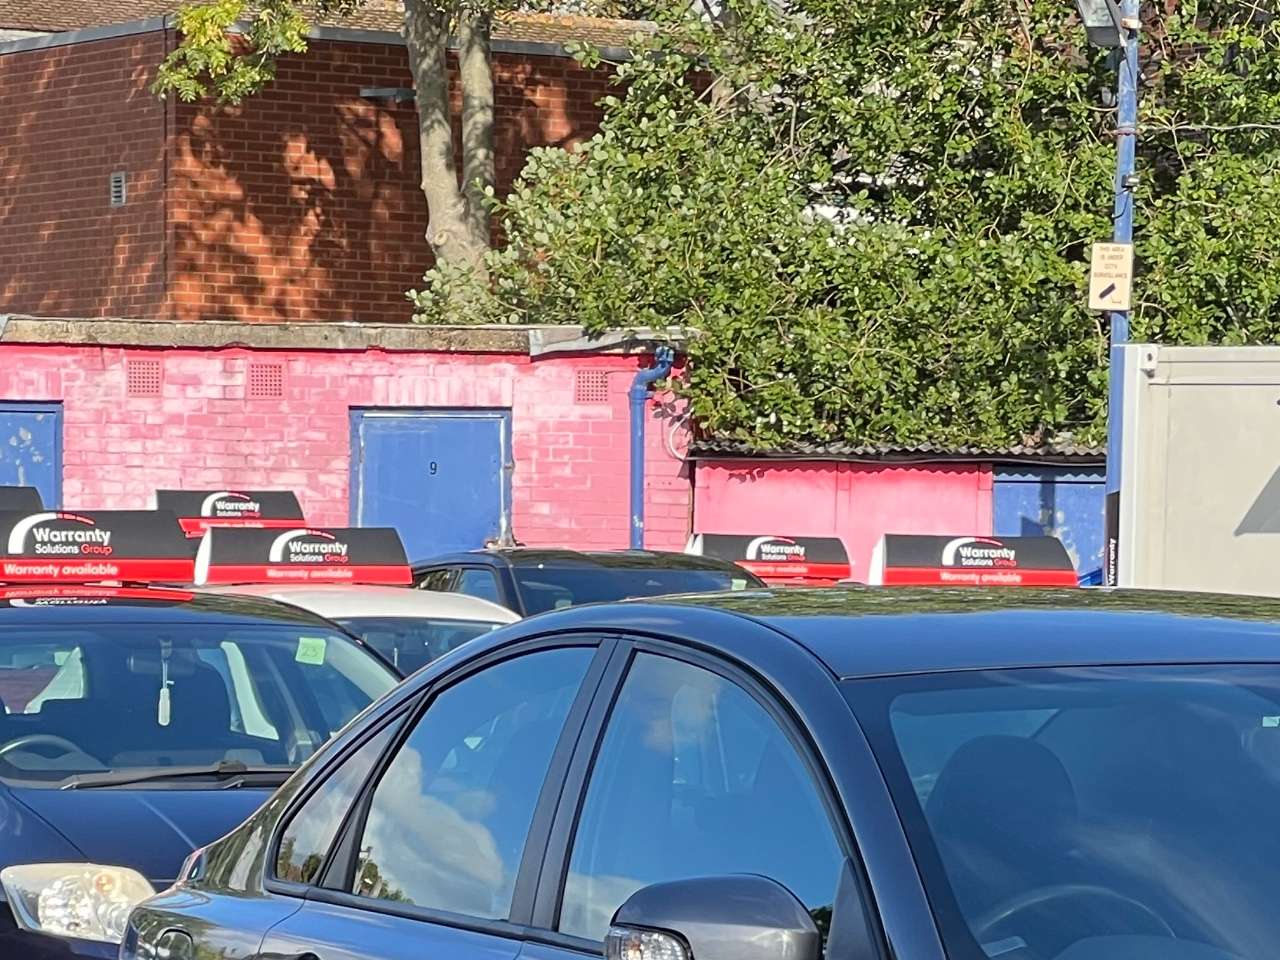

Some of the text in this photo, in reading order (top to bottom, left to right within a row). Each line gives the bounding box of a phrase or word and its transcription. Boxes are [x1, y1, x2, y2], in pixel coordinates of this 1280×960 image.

[430, 461, 437, 475] 9
[215, 500, 260, 513] Warranty
[33, 527, 111, 546] Warranty
[35, 544, 112, 555] Solutions Group
[289, 541, 348, 556] Warranty
[760, 544, 805, 556] Warranty
[959, 547, 1016, 560] Warranty
[290, 554, 349, 563] Solutions Group
[962, 558, 1017, 567] Solutions Group
[1108, 538, 1117, 586] Warranty
[3, 563, 118, 578] Warranty available
[267, 568, 353, 579] Warranty available
[940, 572, 1022, 585] Warranty available
